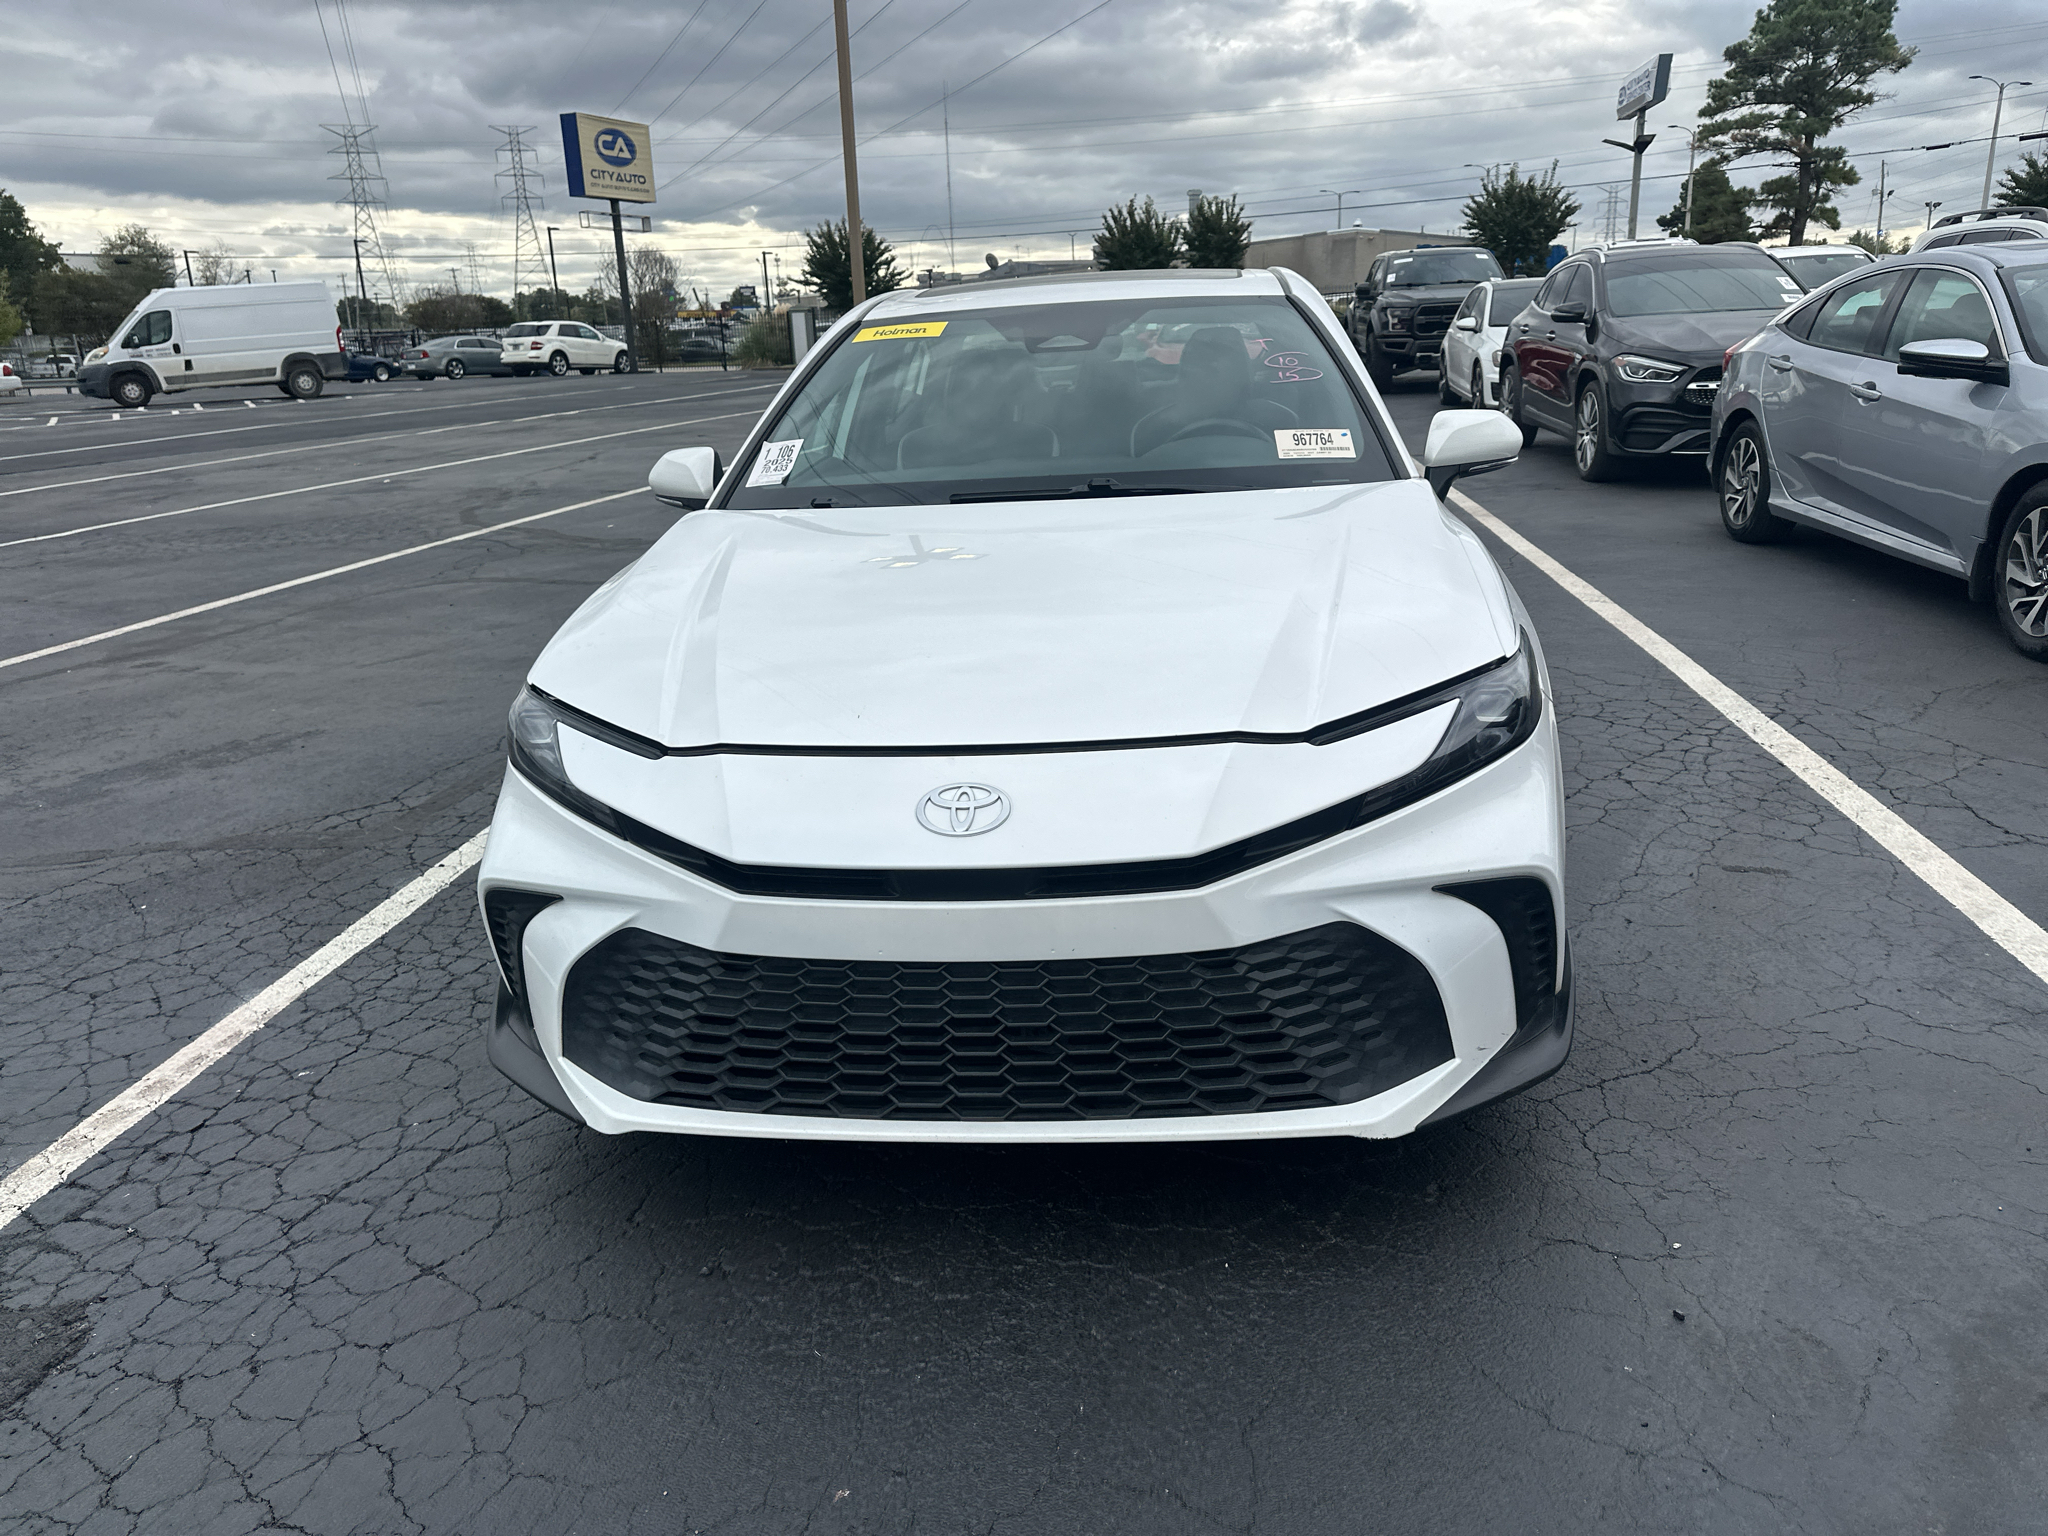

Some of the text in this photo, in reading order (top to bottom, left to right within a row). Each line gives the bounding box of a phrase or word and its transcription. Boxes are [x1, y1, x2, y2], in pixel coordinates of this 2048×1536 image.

[598, 133, 633, 159] CA
[590, 168, 647, 185] CITY AUTO
[873, 327, 927, 338] Holman
[1292, 432, 1334, 446] 967764
[776, 444, 796, 459] 106
[763, 457, 793, 467] 2025
